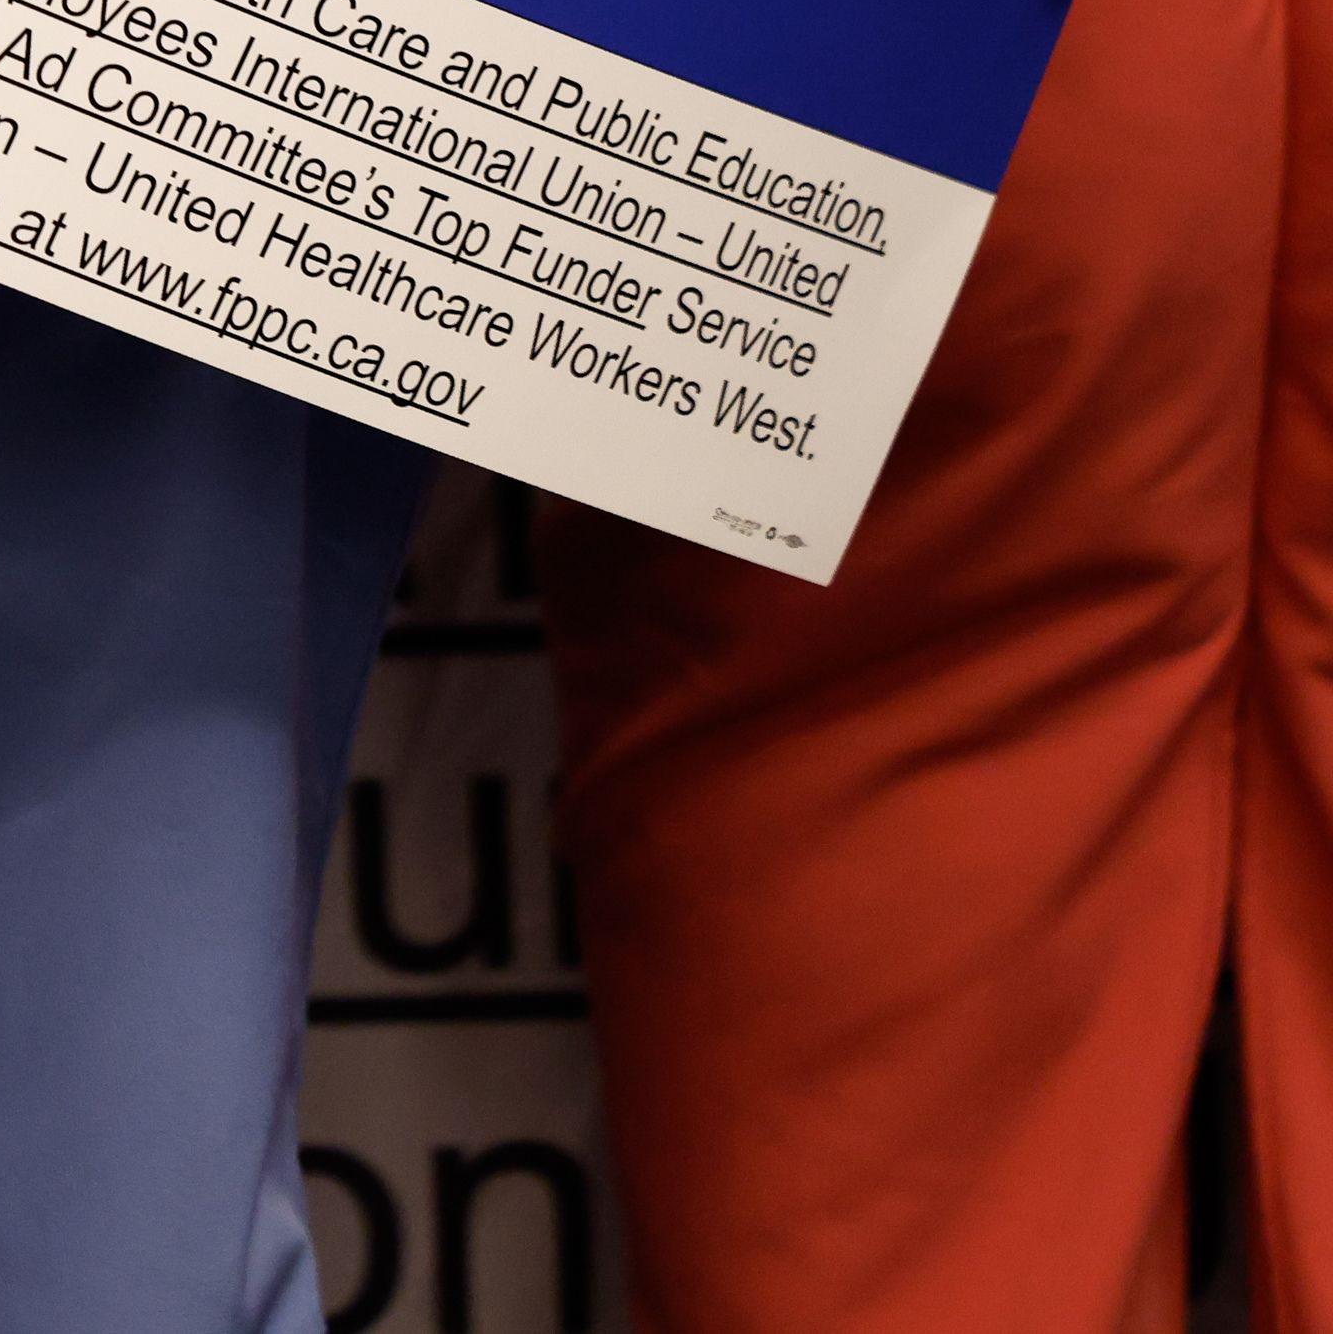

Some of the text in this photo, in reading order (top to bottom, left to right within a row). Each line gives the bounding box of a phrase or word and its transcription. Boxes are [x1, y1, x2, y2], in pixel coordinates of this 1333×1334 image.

[87, 64, 395, 221] Committee’s
[410, 186, 491, 264] Top
[500, 224, 661, 319] Funder
[667, 286, 816, 377] Service
[232, 36, 535, 192] International
[540, 156, 666, 243] Union
[717, 222, 850, 307] United
[441, 50, 538, 111] and
[541, 76, 678, 165] Public
[685, 131, 888, 251] Education,
[9, 209, 68, 259] at
[80, 232, 486, 417] www.fppc.ca.gov
[85, 142, 255, 247] United
[259, 213, 514, 348] Healthcare
[528, 312, 701, 416] Workers
[713, 380, 817, 460] West.
